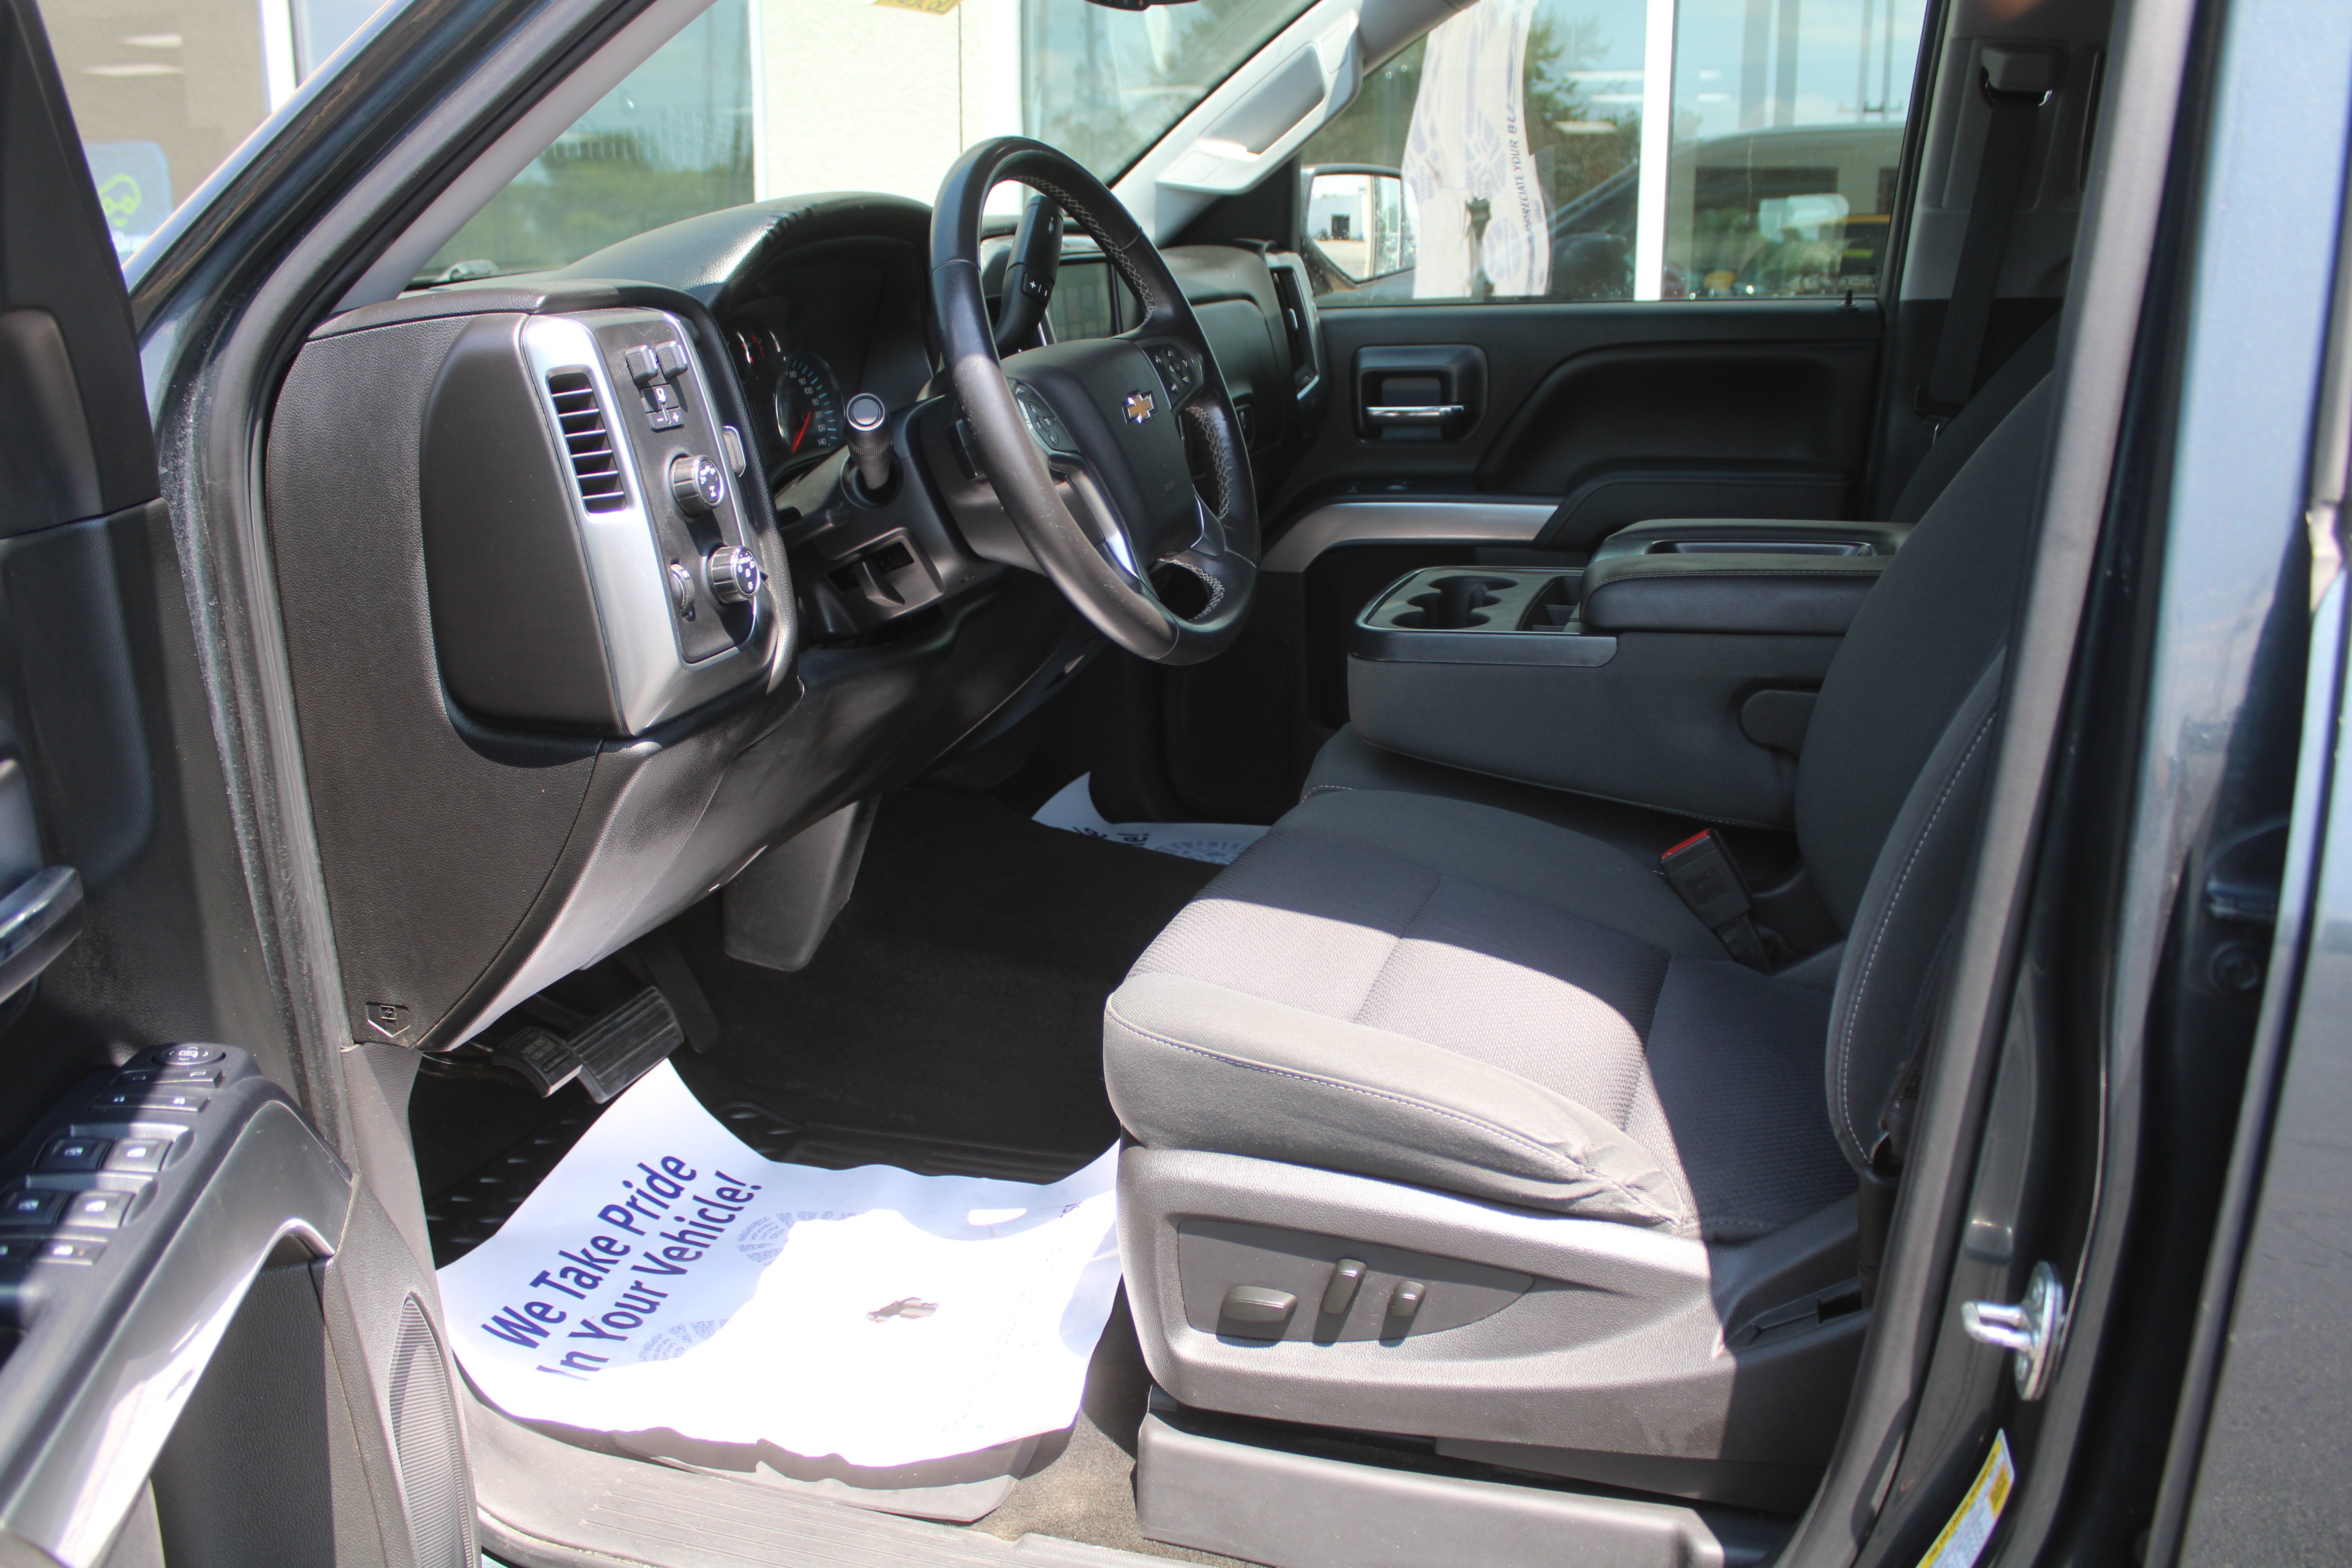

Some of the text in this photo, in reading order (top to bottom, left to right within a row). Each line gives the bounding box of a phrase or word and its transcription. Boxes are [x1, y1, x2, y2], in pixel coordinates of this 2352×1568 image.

[1510, 140, 1522, 172] YOUR
[799, 377, 806, 386] 90
[804, 387, 813, 395] 100
[818, 424, 826, 432] 130
[817, 437, 827, 446] 140
[481, 1156, 697, 1349] We Take Pride
[536, 1170, 762, 1381] In Your Vehicle!
